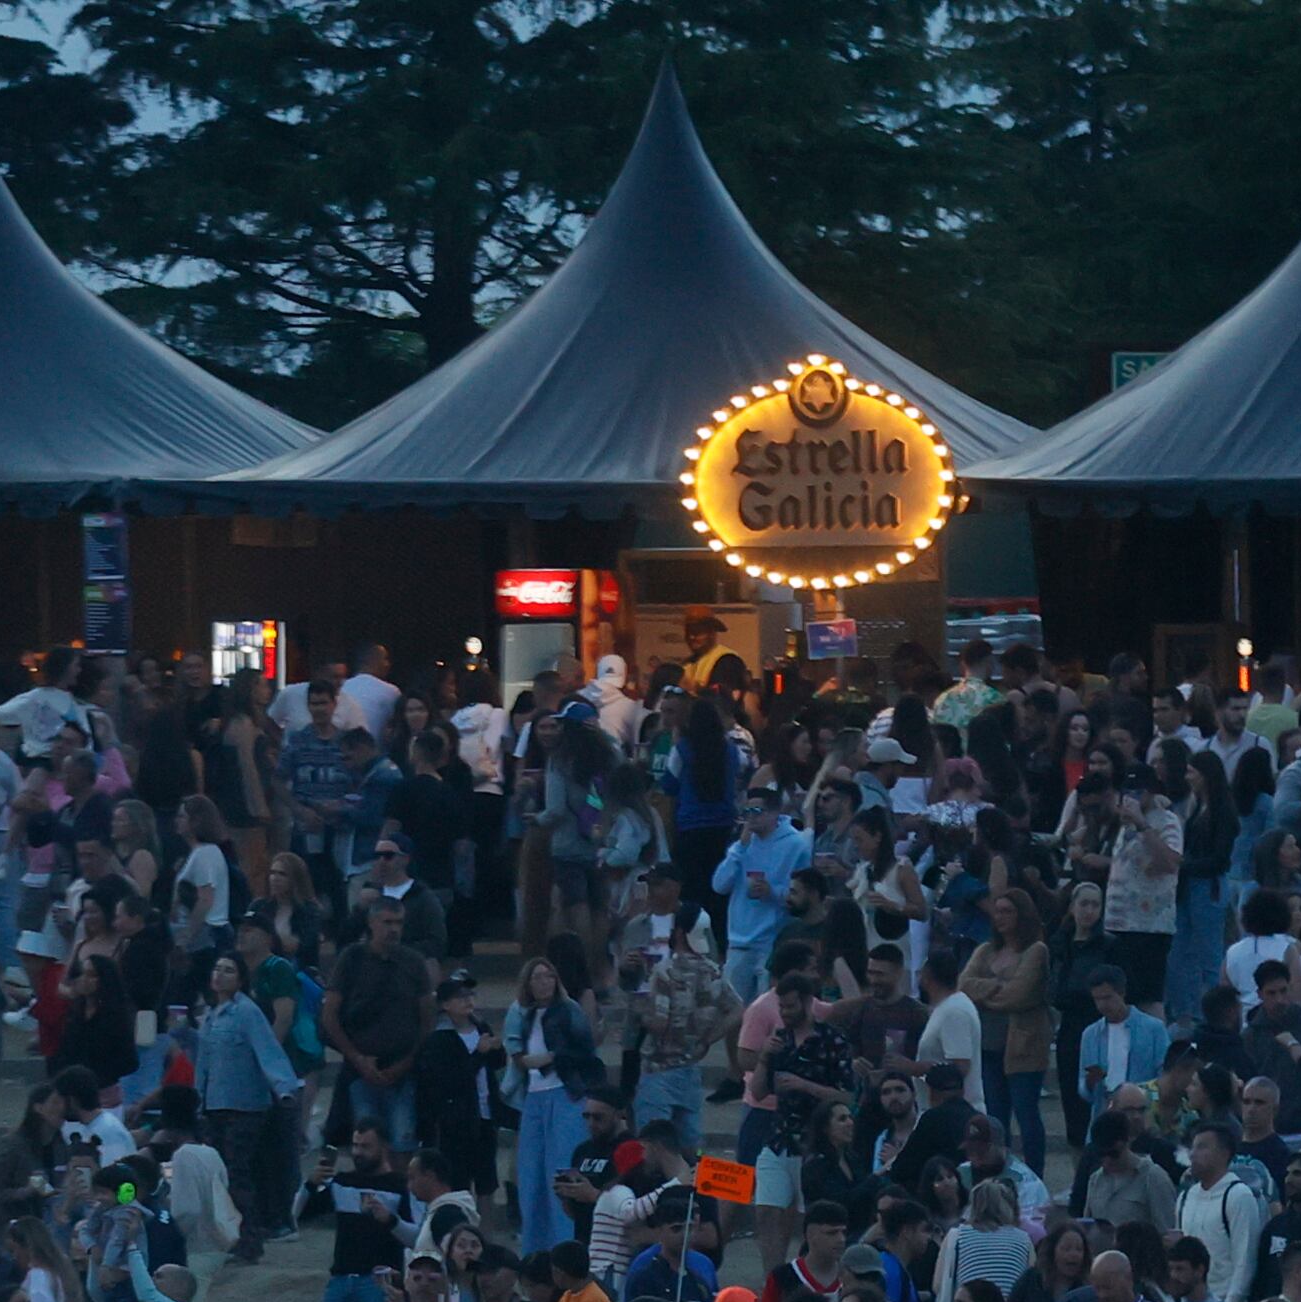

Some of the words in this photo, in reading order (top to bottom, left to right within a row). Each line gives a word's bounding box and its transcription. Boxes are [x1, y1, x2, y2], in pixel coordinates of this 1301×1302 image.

[731, 427, 909, 477] Estrella
[737, 480, 901, 532] Galicia
[712, 1173, 738, 1184] BEER
